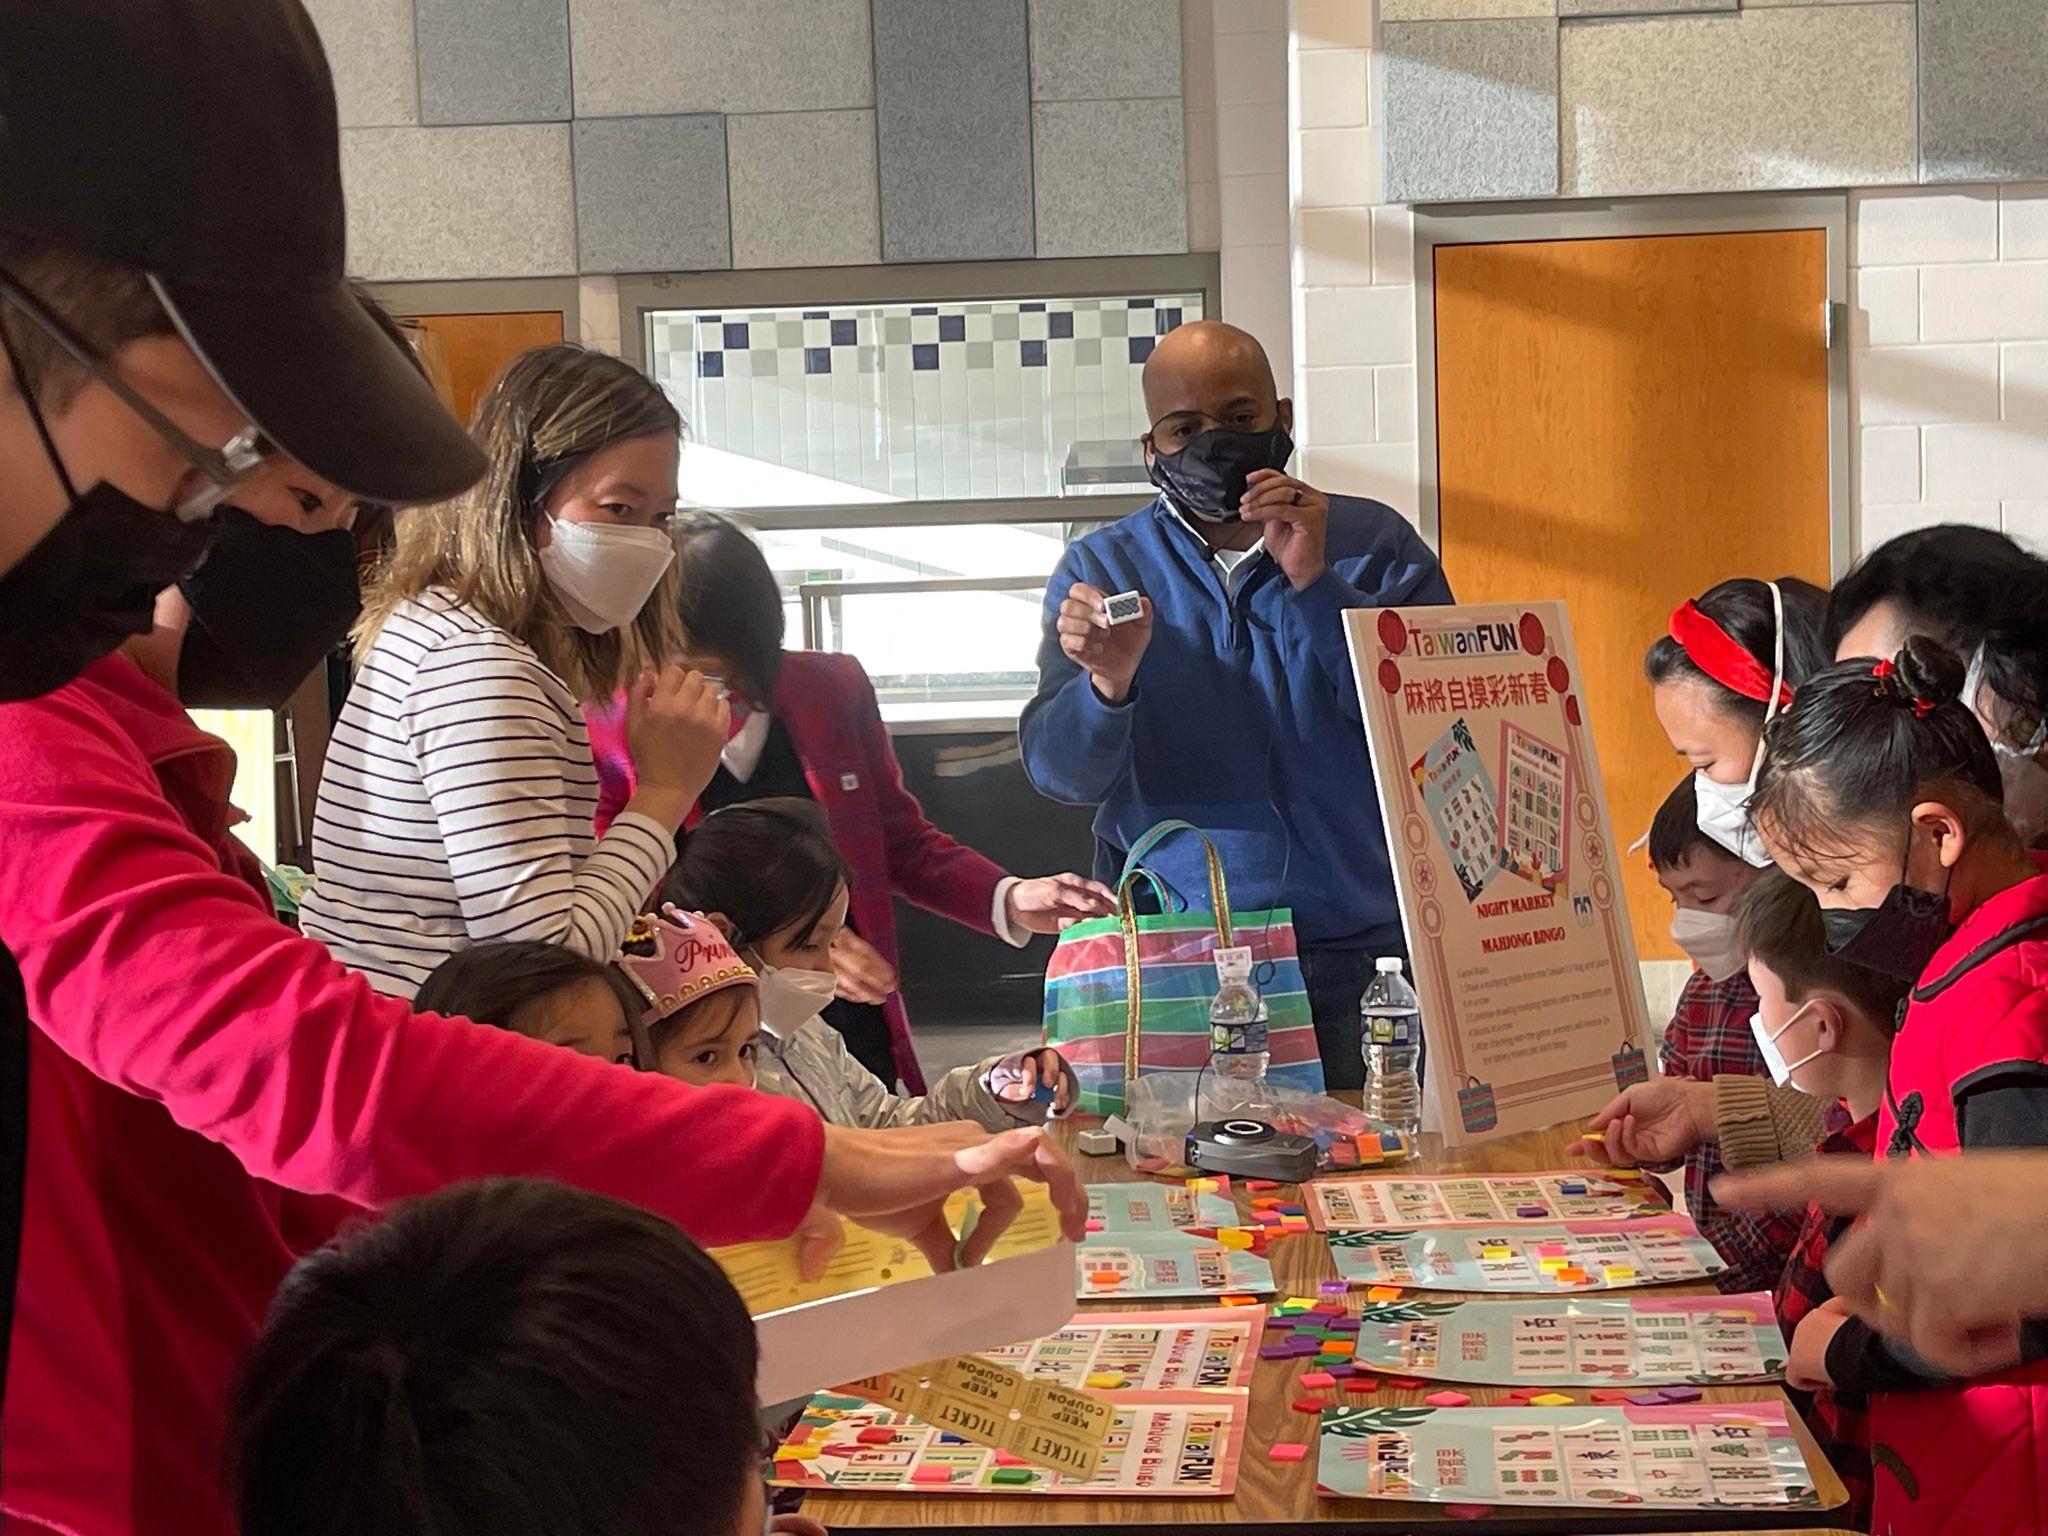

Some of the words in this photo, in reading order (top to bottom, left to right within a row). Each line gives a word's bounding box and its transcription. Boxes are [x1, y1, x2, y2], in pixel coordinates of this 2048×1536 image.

[1408, 622, 1519, 657] TaiwanFUN
[1403, 671, 1550, 715] 麻將自摸彩新春
[1476, 900, 1510, 919] NIGHT
[1510, 894, 1555, 912] MARKET
[1481, 931, 1533, 954] MAHJONG
[1532, 926, 1566, 945] BINGO
[957, 1359, 1015, 1388] COUPON
[1197, 1335, 1241, 1386] TawanFUN
[961, 1379, 999, 1400] KEEP
[1046, 1390, 1105, 1418] COUPON
[938, 1403, 997, 1438] TICKET
[1052, 1410, 1090, 1430] KEEP
[1143, 1412, 1174, 1455] Mahjong
[1031, 1436, 1087, 1470] TICKET
[1179, 1419, 1223, 1482] TawanFUN
[1377, 1438, 1411, 1496] TawanFUN
[1135, 1457, 1165, 1489] Bingo
